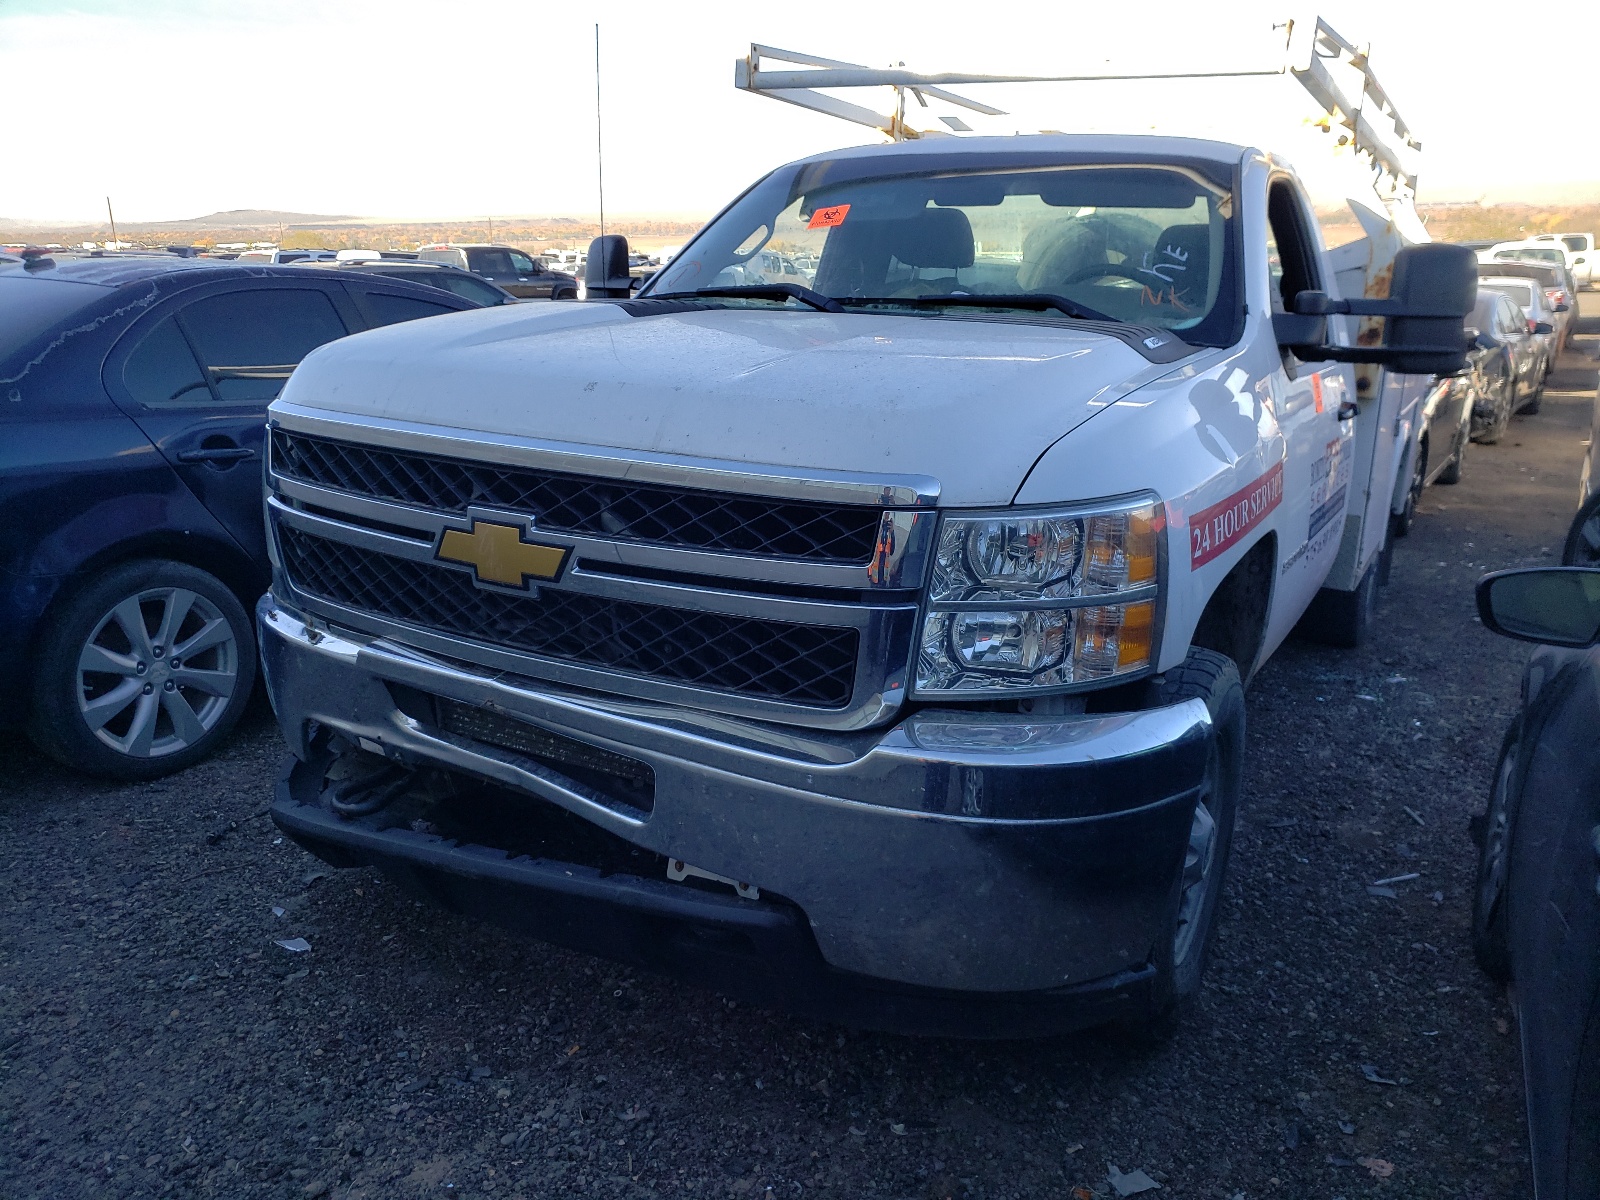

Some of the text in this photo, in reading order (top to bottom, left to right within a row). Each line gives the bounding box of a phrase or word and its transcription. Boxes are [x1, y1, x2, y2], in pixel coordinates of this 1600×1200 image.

[1193, 522, 1211, 558] 24
[1213, 499, 1249, 547] HOUR
[1250, 469, 1283, 519] SERVICE
